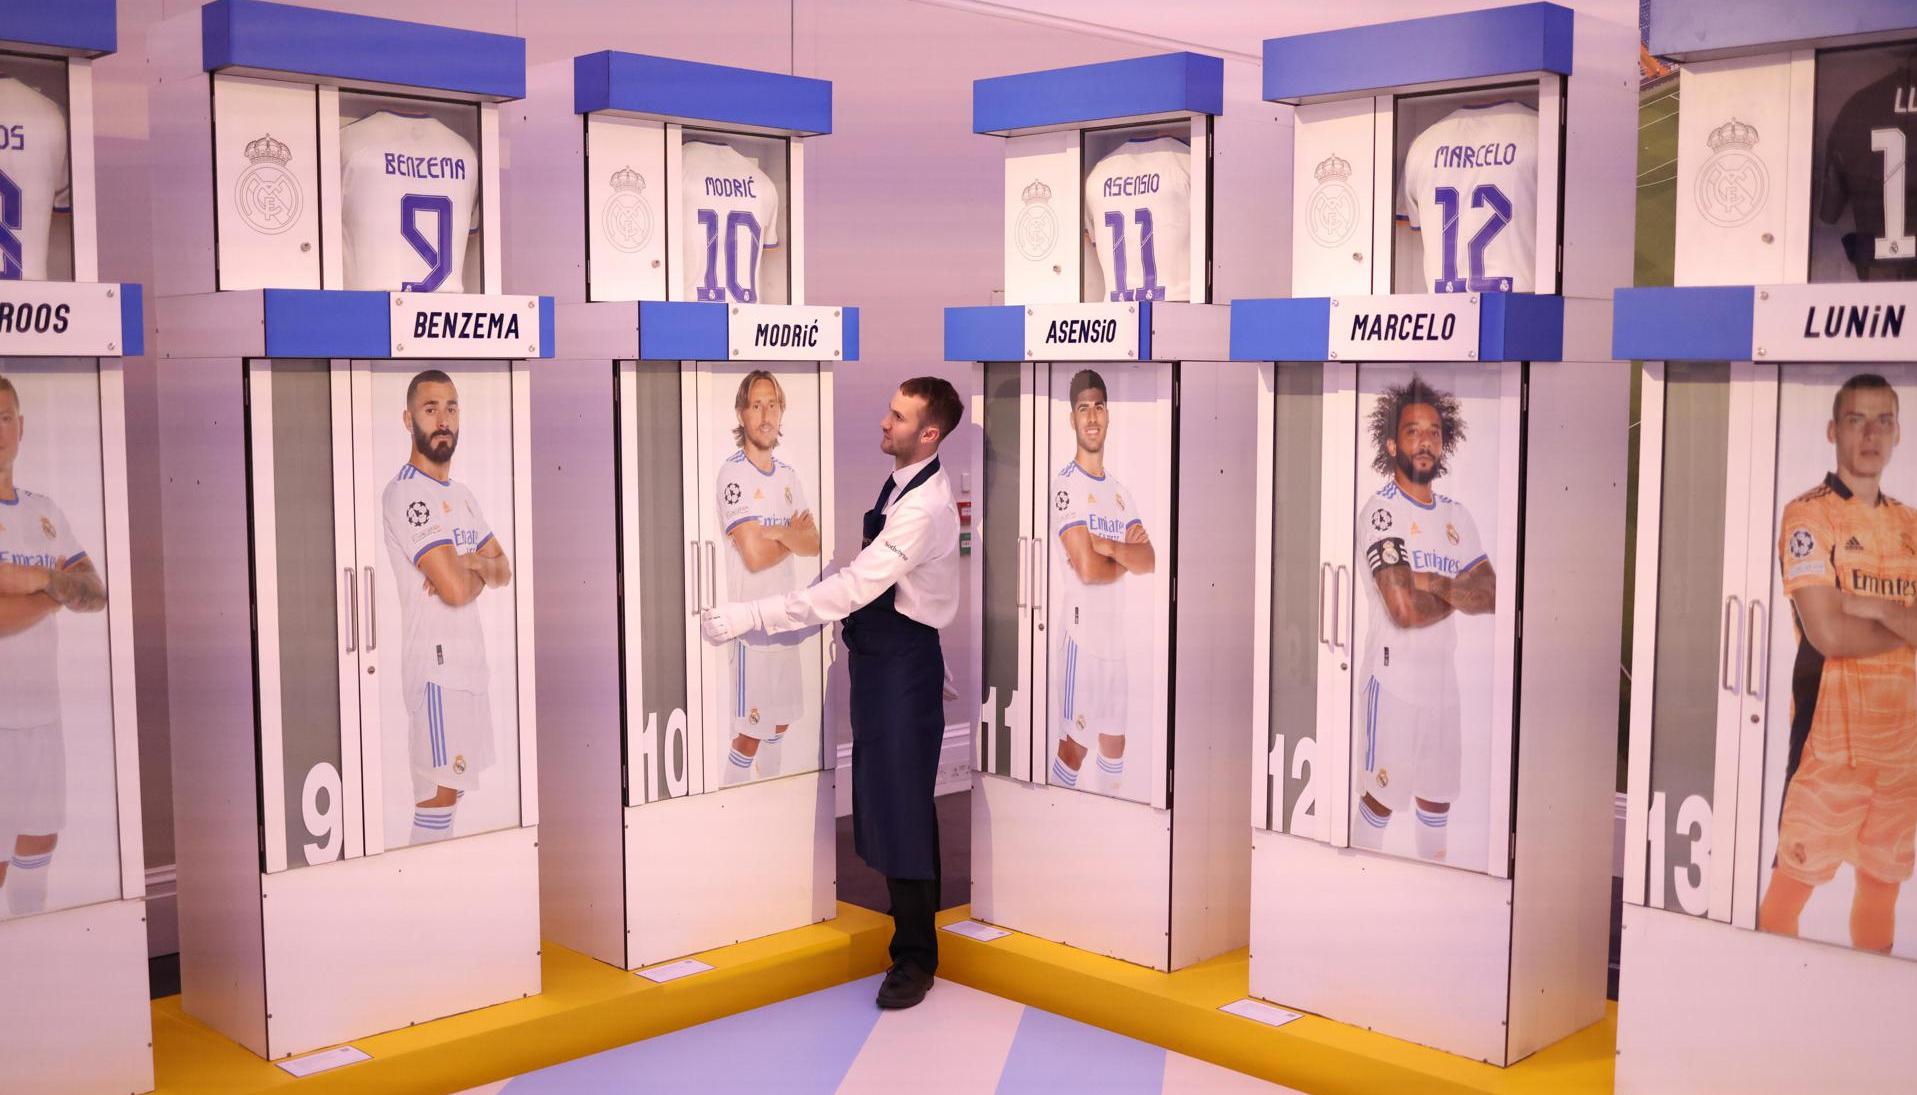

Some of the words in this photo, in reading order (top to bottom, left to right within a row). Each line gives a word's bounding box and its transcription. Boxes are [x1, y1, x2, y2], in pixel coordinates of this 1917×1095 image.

[385, 152, 466, 180] BENZEMA
[705, 176, 757, 199] MODRIĆ
[1103, 173, 1160, 198] ASENSIO
[1434, 143, 1516, 169] MARCELO
[400, 193, 453, 293] 9
[697, 208, 762, 304] 10
[1104, 207, 1166, 302] 11
[1434, 184, 1514, 294] 12
[413, 311, 520, 340] BENZEMA
[1350, 313, 1456, 341] MARCELO
[641, 707, 688, 804] 10
[1267, 733, 1317, 838] 12
[302, 761, 343, 867] 9
[1648, 791, 1712, 916] 13
